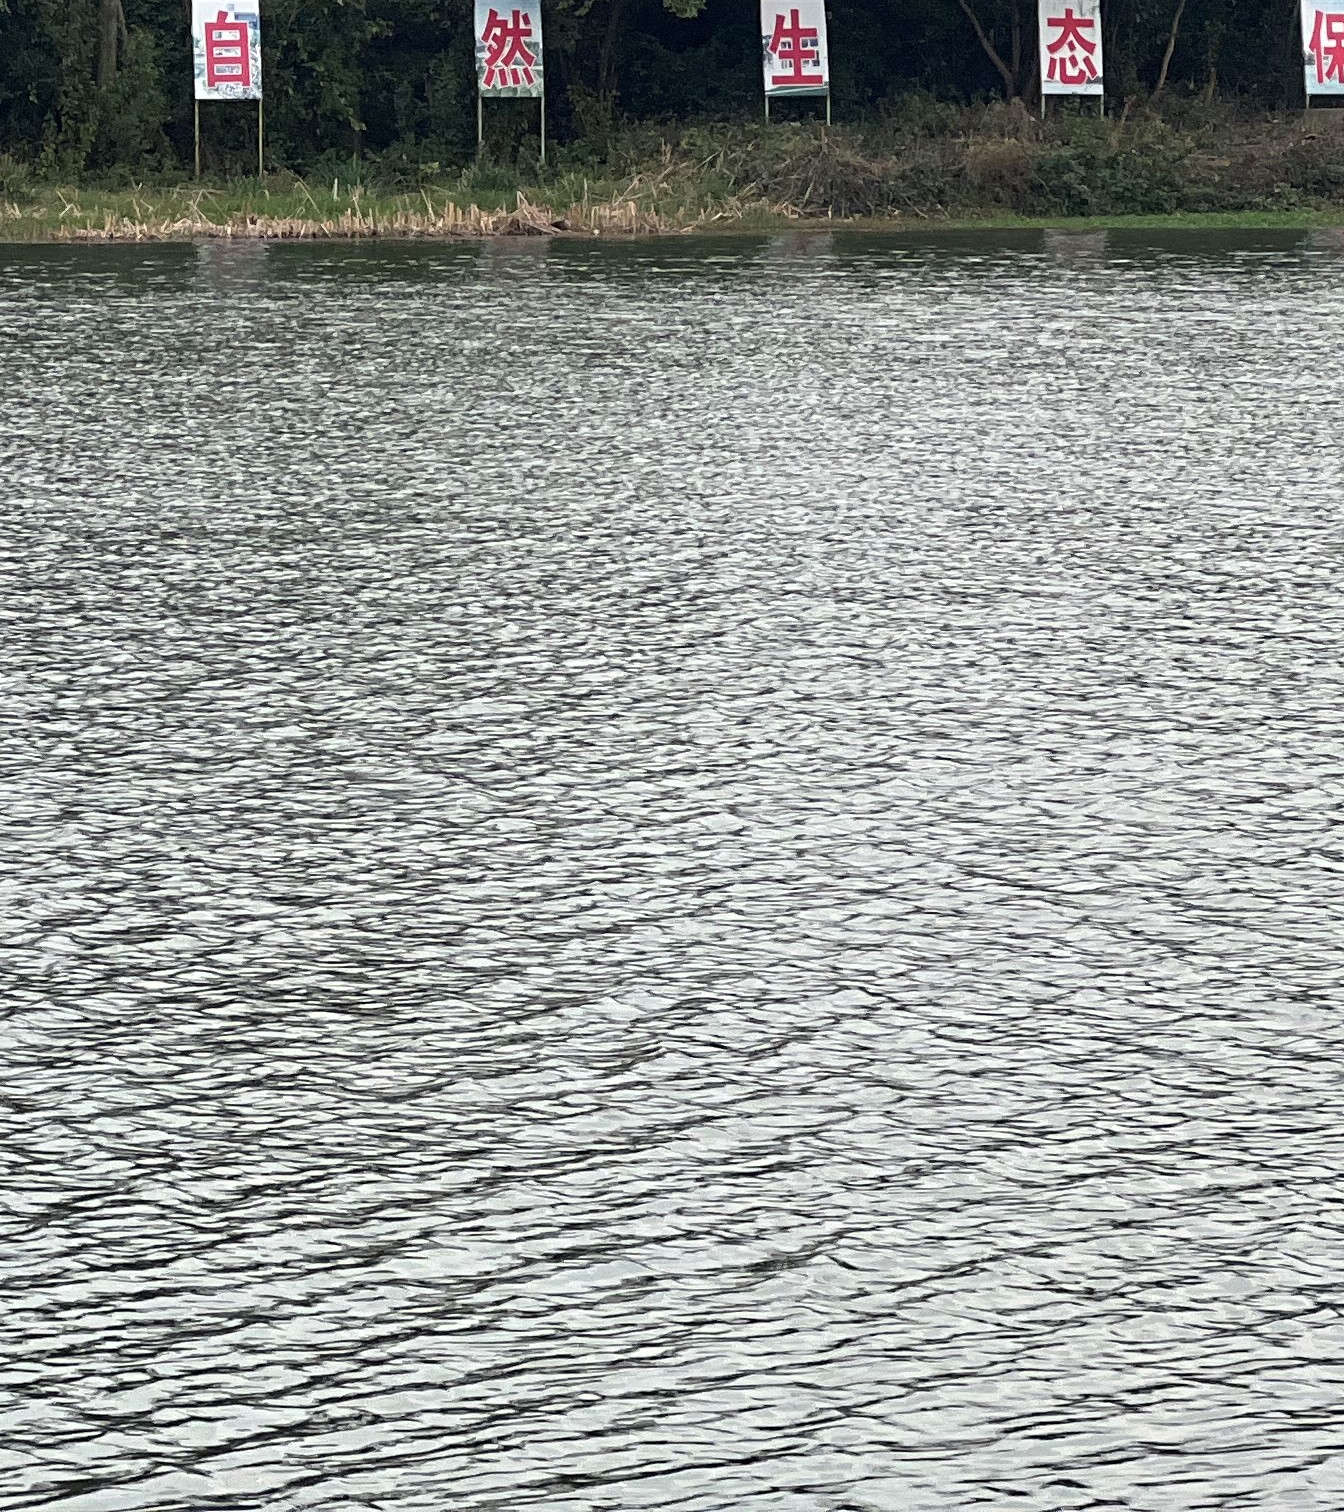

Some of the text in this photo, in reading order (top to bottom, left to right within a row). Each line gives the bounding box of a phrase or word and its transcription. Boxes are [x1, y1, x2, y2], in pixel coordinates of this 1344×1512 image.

[205, 11, 251, 88] 自
[483, 10, 536, 87] 然
[770, 10, 824, 86] 生
[1047, 8, 1098, 86] 态
